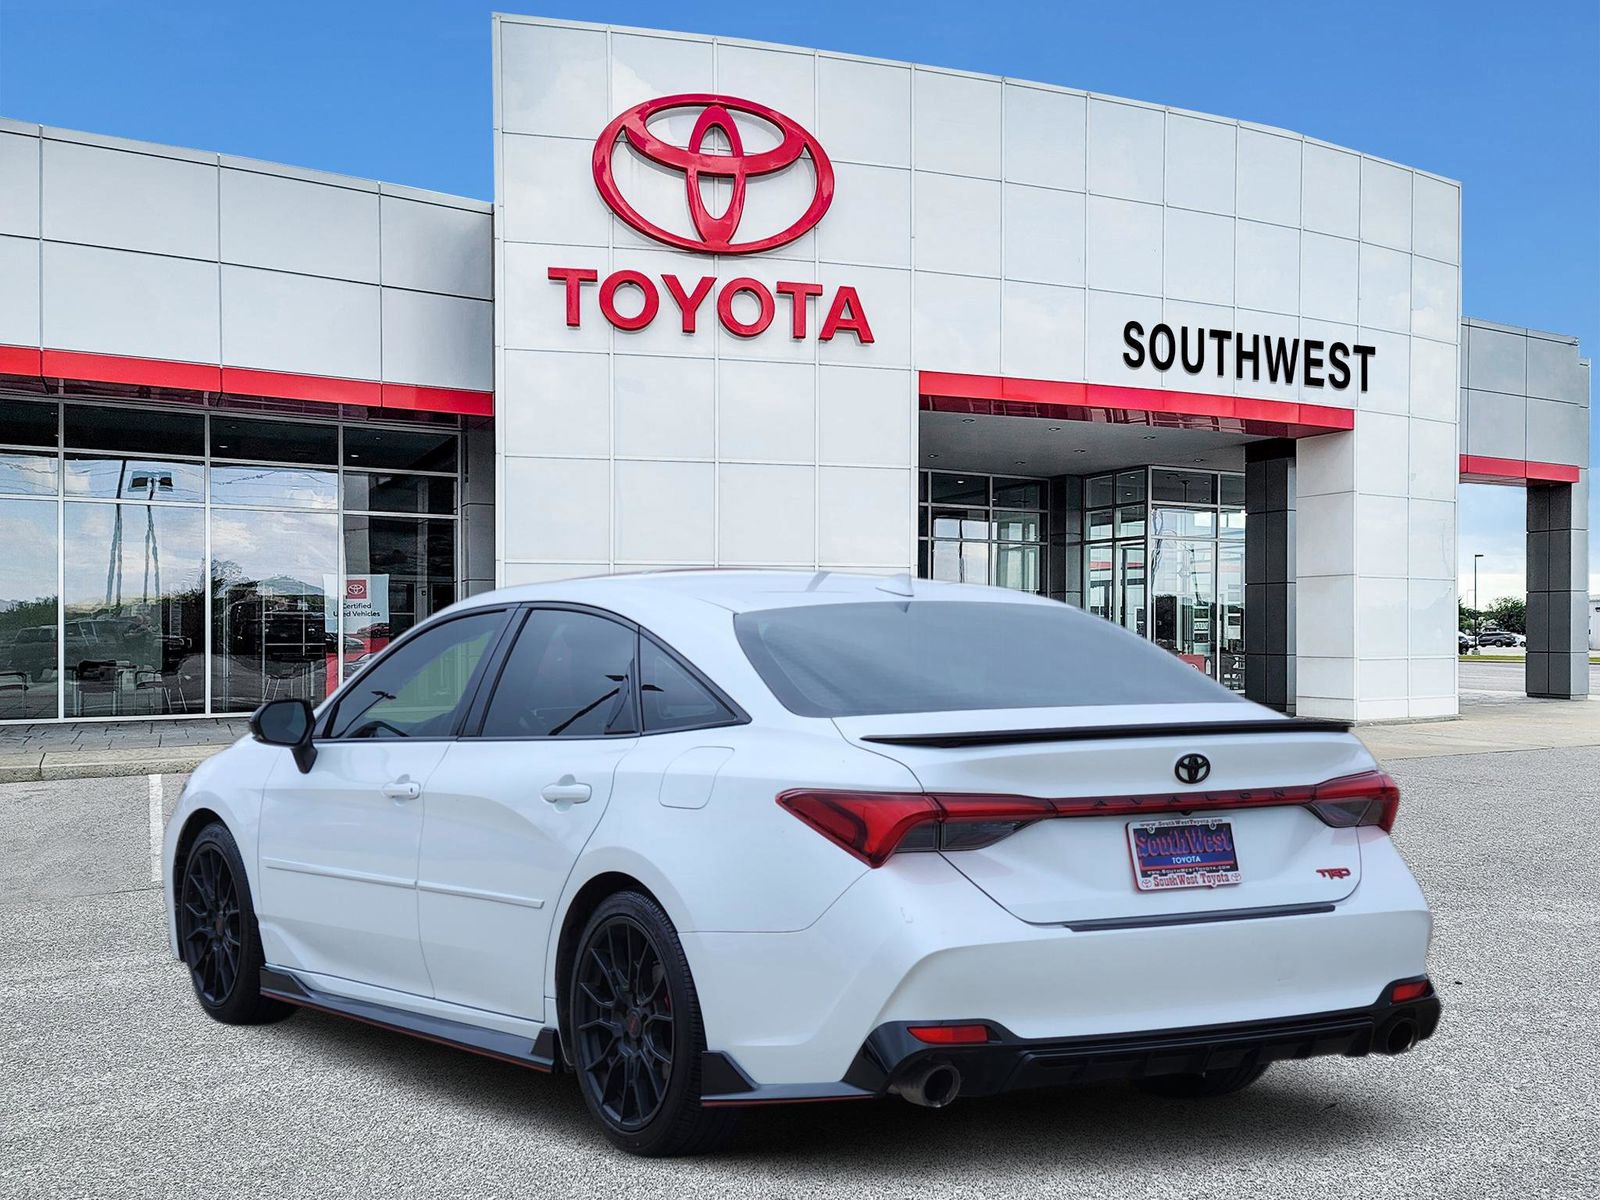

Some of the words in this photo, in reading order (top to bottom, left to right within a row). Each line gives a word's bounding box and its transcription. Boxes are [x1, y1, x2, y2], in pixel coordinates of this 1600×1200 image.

[547, 266, 875, 344] TOYOTA
[1123, 320, 1376, 392] SOUTHWEST
[1094, 790, 1285, 807] AVALON
[1172, 855, 1201, 864] TOYOTA
[1153, 873, 1199, 887] SouthWest
[1200, 871, 1230, 885] Toyota
[1315, 868, 1351, 880] TRD
